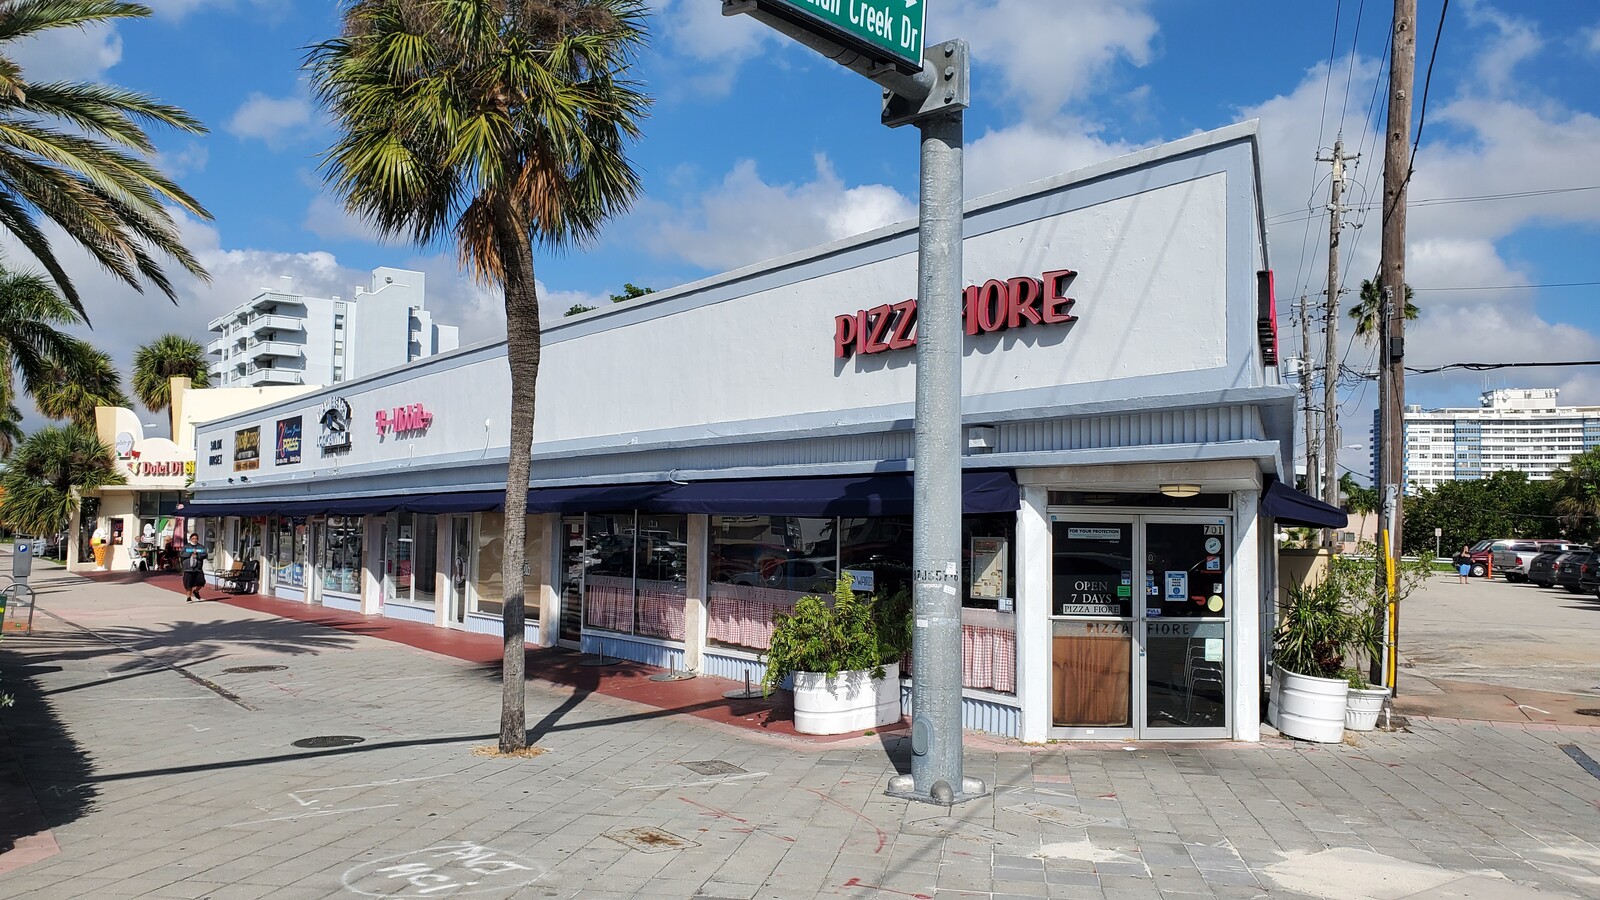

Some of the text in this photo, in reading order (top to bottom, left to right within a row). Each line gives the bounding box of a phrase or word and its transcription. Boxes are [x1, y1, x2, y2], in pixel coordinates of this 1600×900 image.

[849, 0, 893, 41] Creek
[900, 15, 918, 52] Dr
[834, 269, 1078, 358] PIZZ IORE
[171, 461, 183, 474] Di
[1074, 581, 1108, 591] OPEN
[1071, 594, 1112, 604] 7 DAYS
[1086, 622, 1189, 635] PIZZA FIORE
